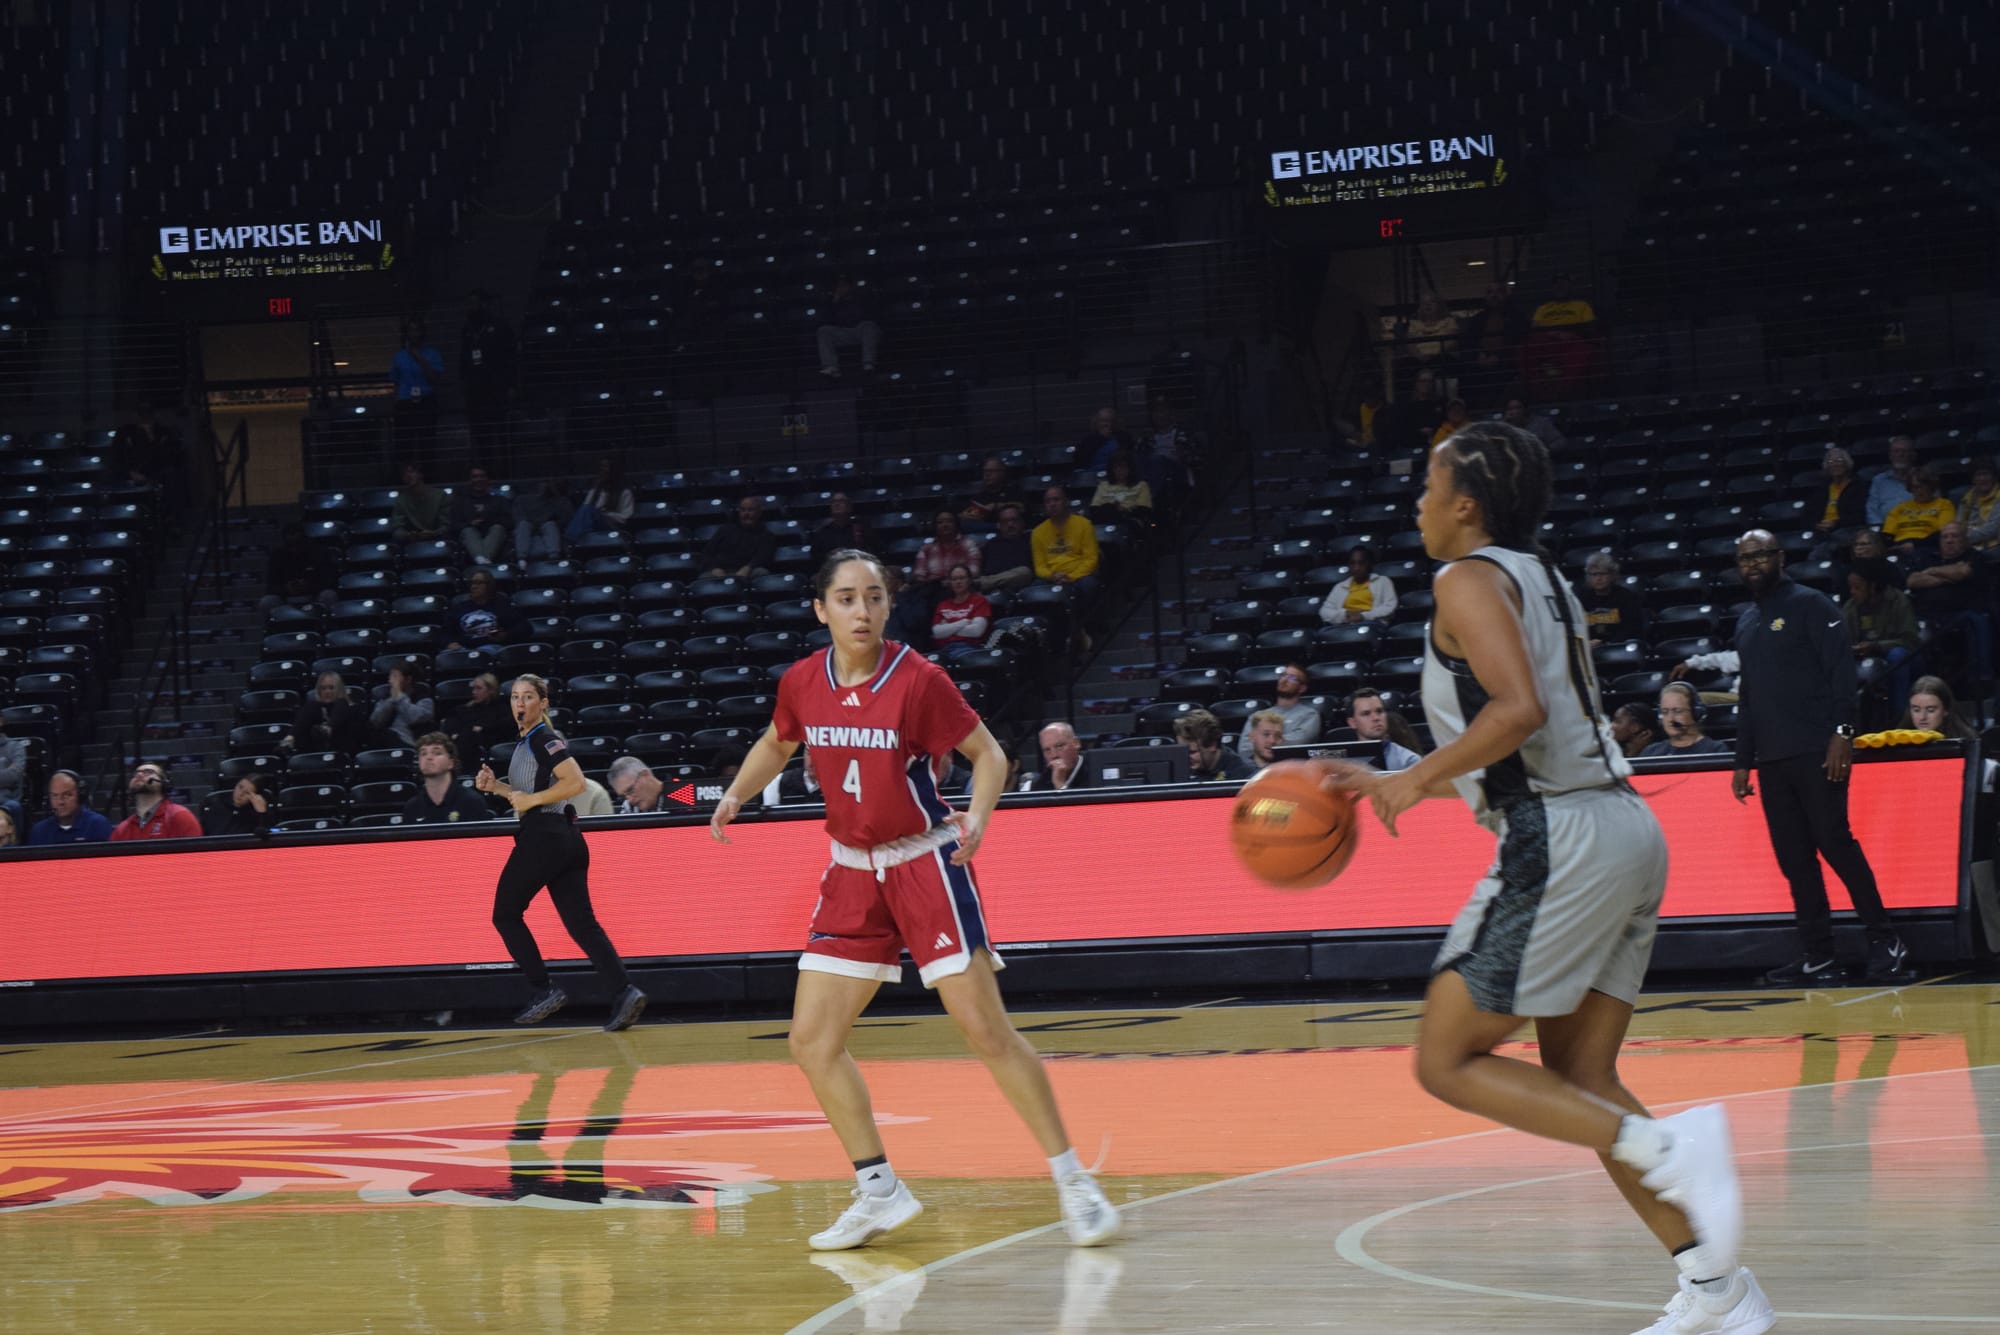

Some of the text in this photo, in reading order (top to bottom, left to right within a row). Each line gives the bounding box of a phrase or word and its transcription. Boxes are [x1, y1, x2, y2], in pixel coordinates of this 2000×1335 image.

[1304, 141, 1423, 175] EMPRISE
[1301, 169, 1467, 193] Your Partner in Possible
[1284, 192, 1332, 206] Member
[1336, 189, 1365, 201] FDIC
[193, 223, 312, 251] EMPRISE
[190, 252, 355, 269] Your Partner in Possible
[172, 270, 220, 281] Member
[224, 267, 254, 278] FDIC
[804, 725, 899, 750] NEWMAN
[842, 759, 862, 804] 4
